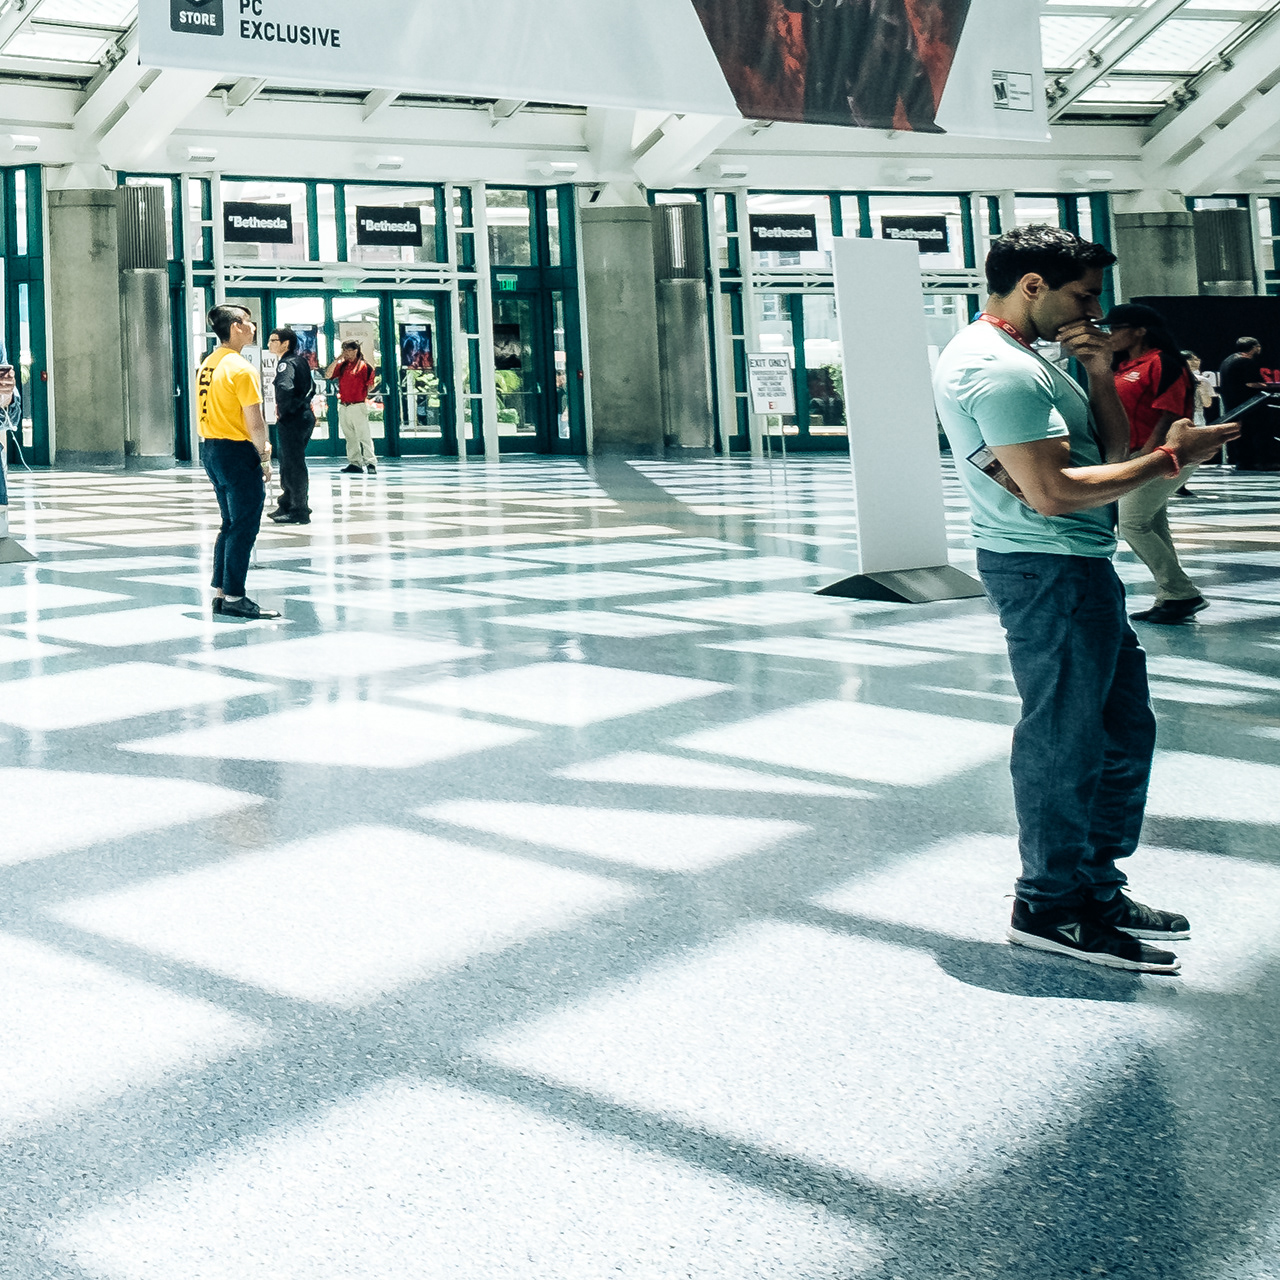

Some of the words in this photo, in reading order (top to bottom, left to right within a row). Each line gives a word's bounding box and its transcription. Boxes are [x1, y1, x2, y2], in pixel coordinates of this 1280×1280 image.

[179, 11, 216, 26] STORE
[240, 20, 341, 48] EXCLUSIVE
[234, 216, 287, 229] Bethesda
[366, 220, 417, 233] Bethesda
[758, 227, 813, 239] Bethesda
[891, 228, 944, 240] Bethesda
[750, 359, 765, 367] EXIT
[768, 359, 787, 367] ONLY
